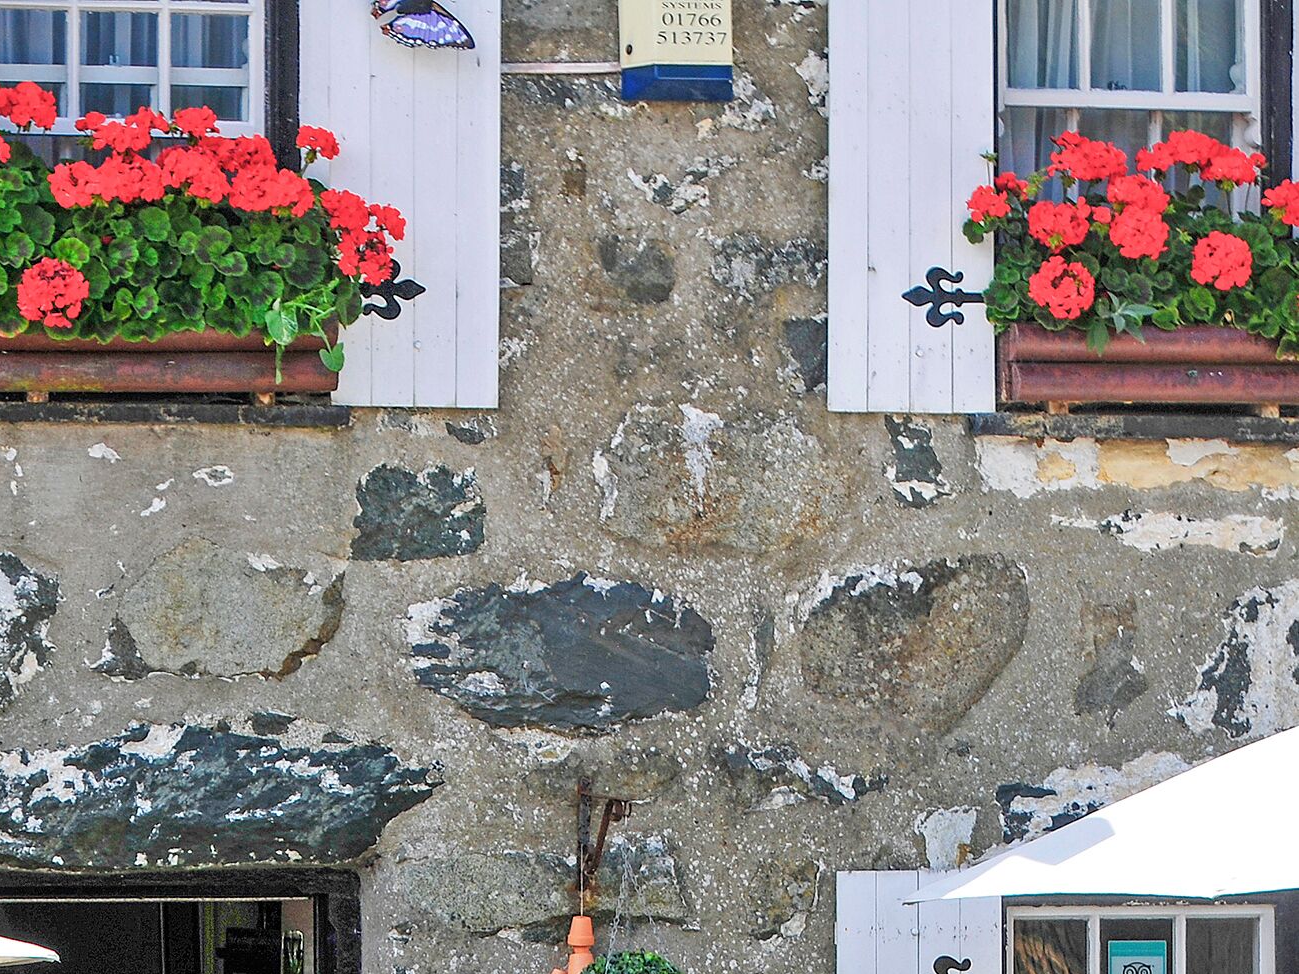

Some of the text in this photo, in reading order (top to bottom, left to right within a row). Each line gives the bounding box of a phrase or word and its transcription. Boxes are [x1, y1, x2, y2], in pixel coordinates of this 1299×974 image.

[661, 1, 722, 9] SYSTEMS
[662, 12, 722, 27] 01766
[656, 30, 727, 45] 513737
